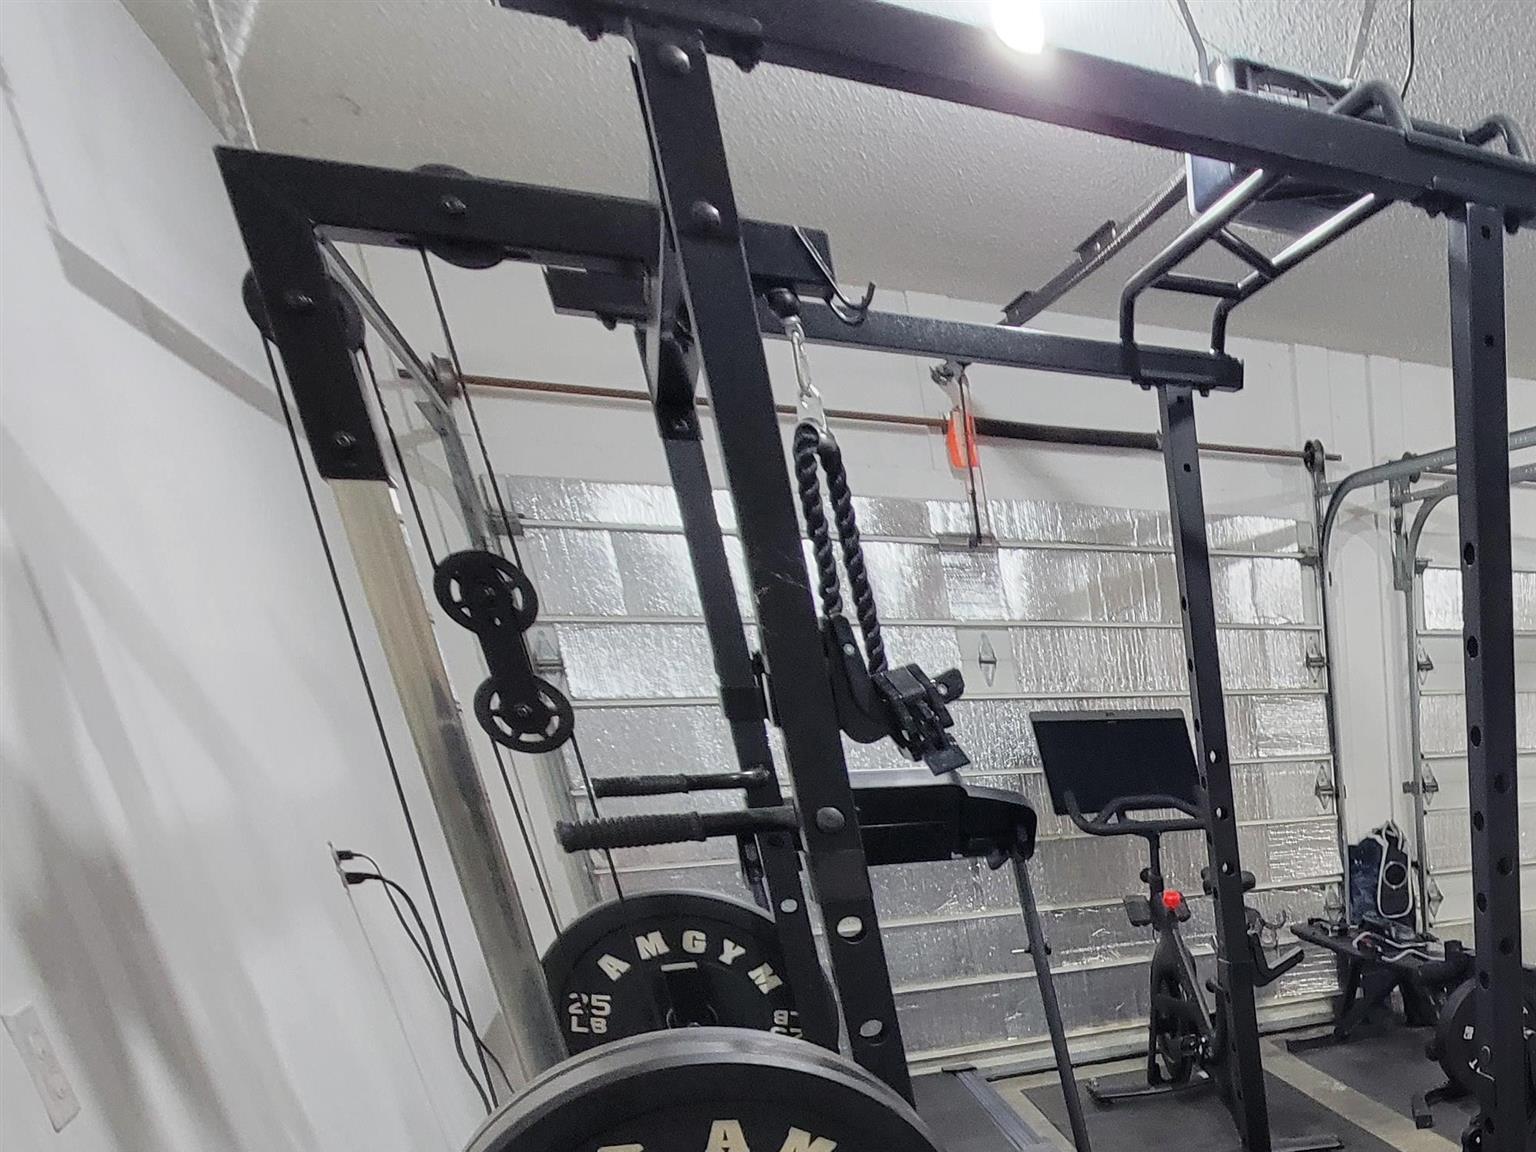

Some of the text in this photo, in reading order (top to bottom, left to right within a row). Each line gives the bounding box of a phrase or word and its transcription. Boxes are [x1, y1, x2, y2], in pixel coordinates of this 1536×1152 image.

[597, 929, 783, 995] AMGYM
[568, 992, 611, 1016] 25
[571, 1016, 608, 1034] LB
